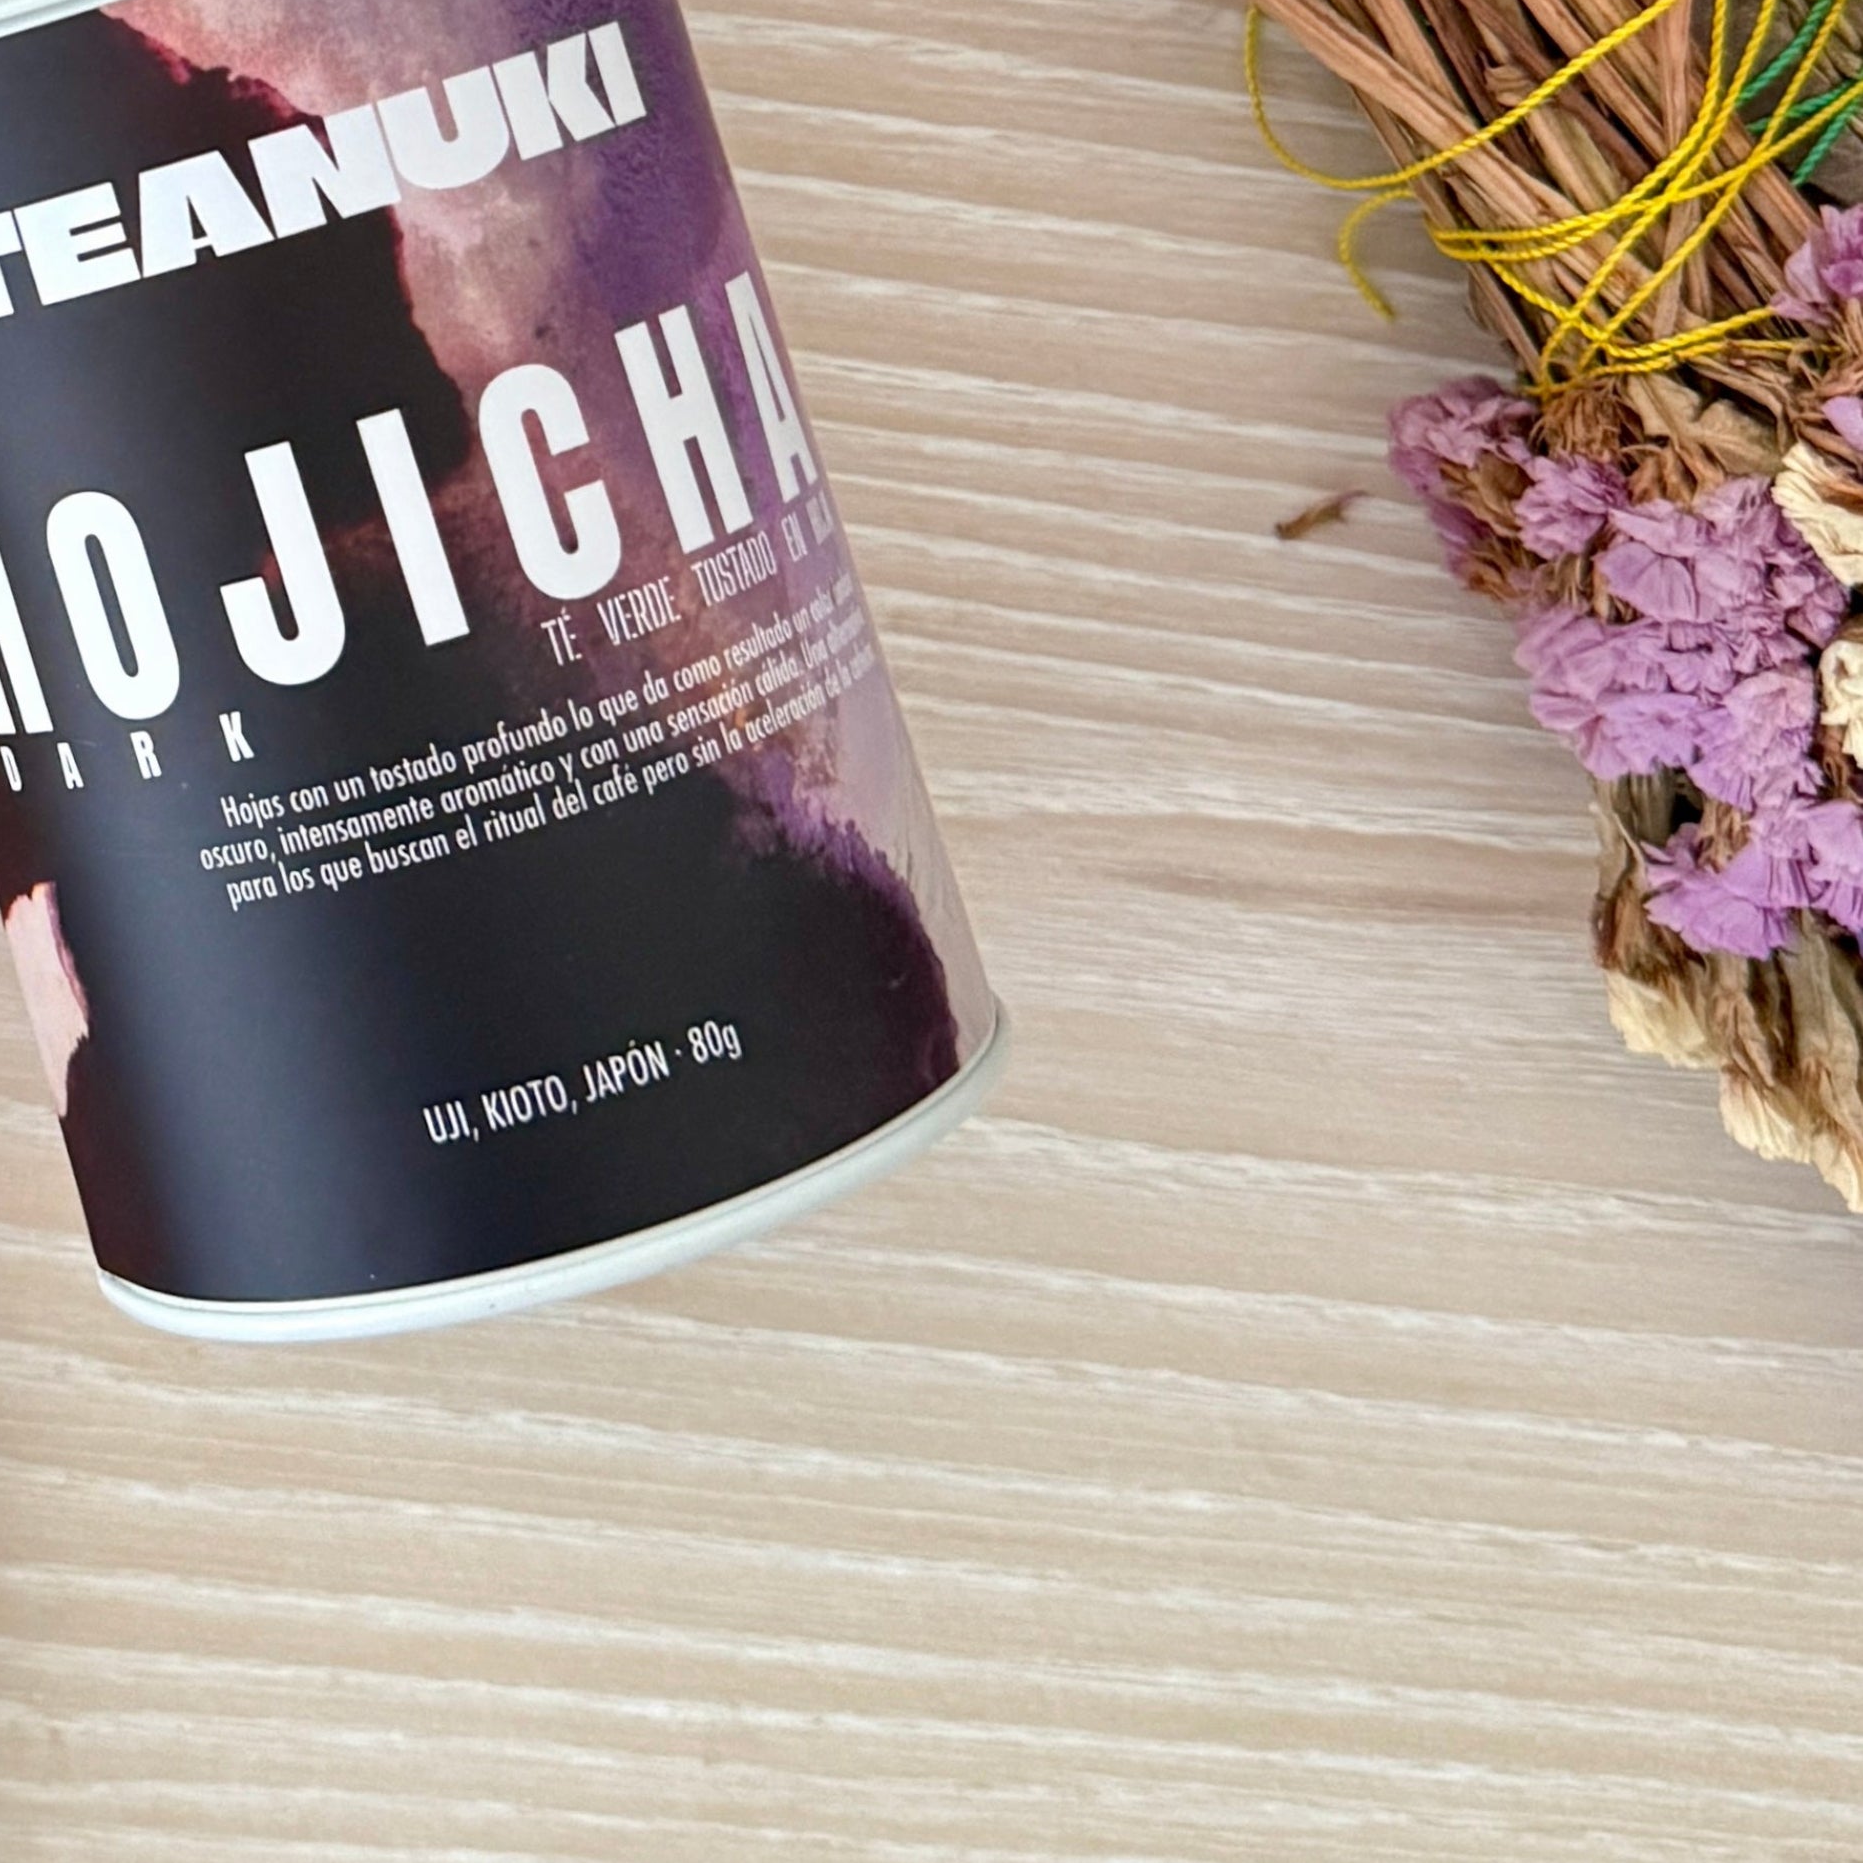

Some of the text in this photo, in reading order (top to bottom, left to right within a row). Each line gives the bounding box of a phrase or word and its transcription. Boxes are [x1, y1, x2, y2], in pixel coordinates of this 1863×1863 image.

[540, 606, 583, 666] TÉ
[596, 575, 682, 647] VERDE
[690, 530, 778, 607] TOSTADO
[0, 711, 254, 792] DARK
[199, 837, 277, 871] oscuro,
[277, 795, 435, 855] intensamente
[440, 760, 556, 814] aromático
[558, 752, 575, 784] y
[579, 737, 620, 769] con
[622, 719, 665, 753] una
[666, 678, 755, 738] sensación
[220, 792, 286, 830] Hojas
[289, 784, 330, 814] con
[333, 775, 366, 803] un
[369, 742, 458, 793] tostado
[461, 707, 569, 775] profundo
[567, 698, 594, 732] lo
[598, 689, 639, 727] que
[641, 669, 670, 706] da
[672, 654, 723, 693] como
[722, 610, 793, 670] resultado
[791, 606, 812, 634] un
[226, 874, 278, 913] para
[278, 860, 316, 895] los
[320, 856, 364, 892] que
[364, 832, 451, 874] buscan
[454, 813, 479, 851] el
[482, 792, 548, 843] ritual
[551, 777, 589, 820] del
[591, 762, 639, 806] café
[641, 751, 690, 796] pero
[691, 735, 723, 768] sin
[719, 720, 744, 755] la
[744, 681, 826, 744] aceleración
[422, 1019, 743, 1144] UJI, KIOTO, JAPÓN 80g
